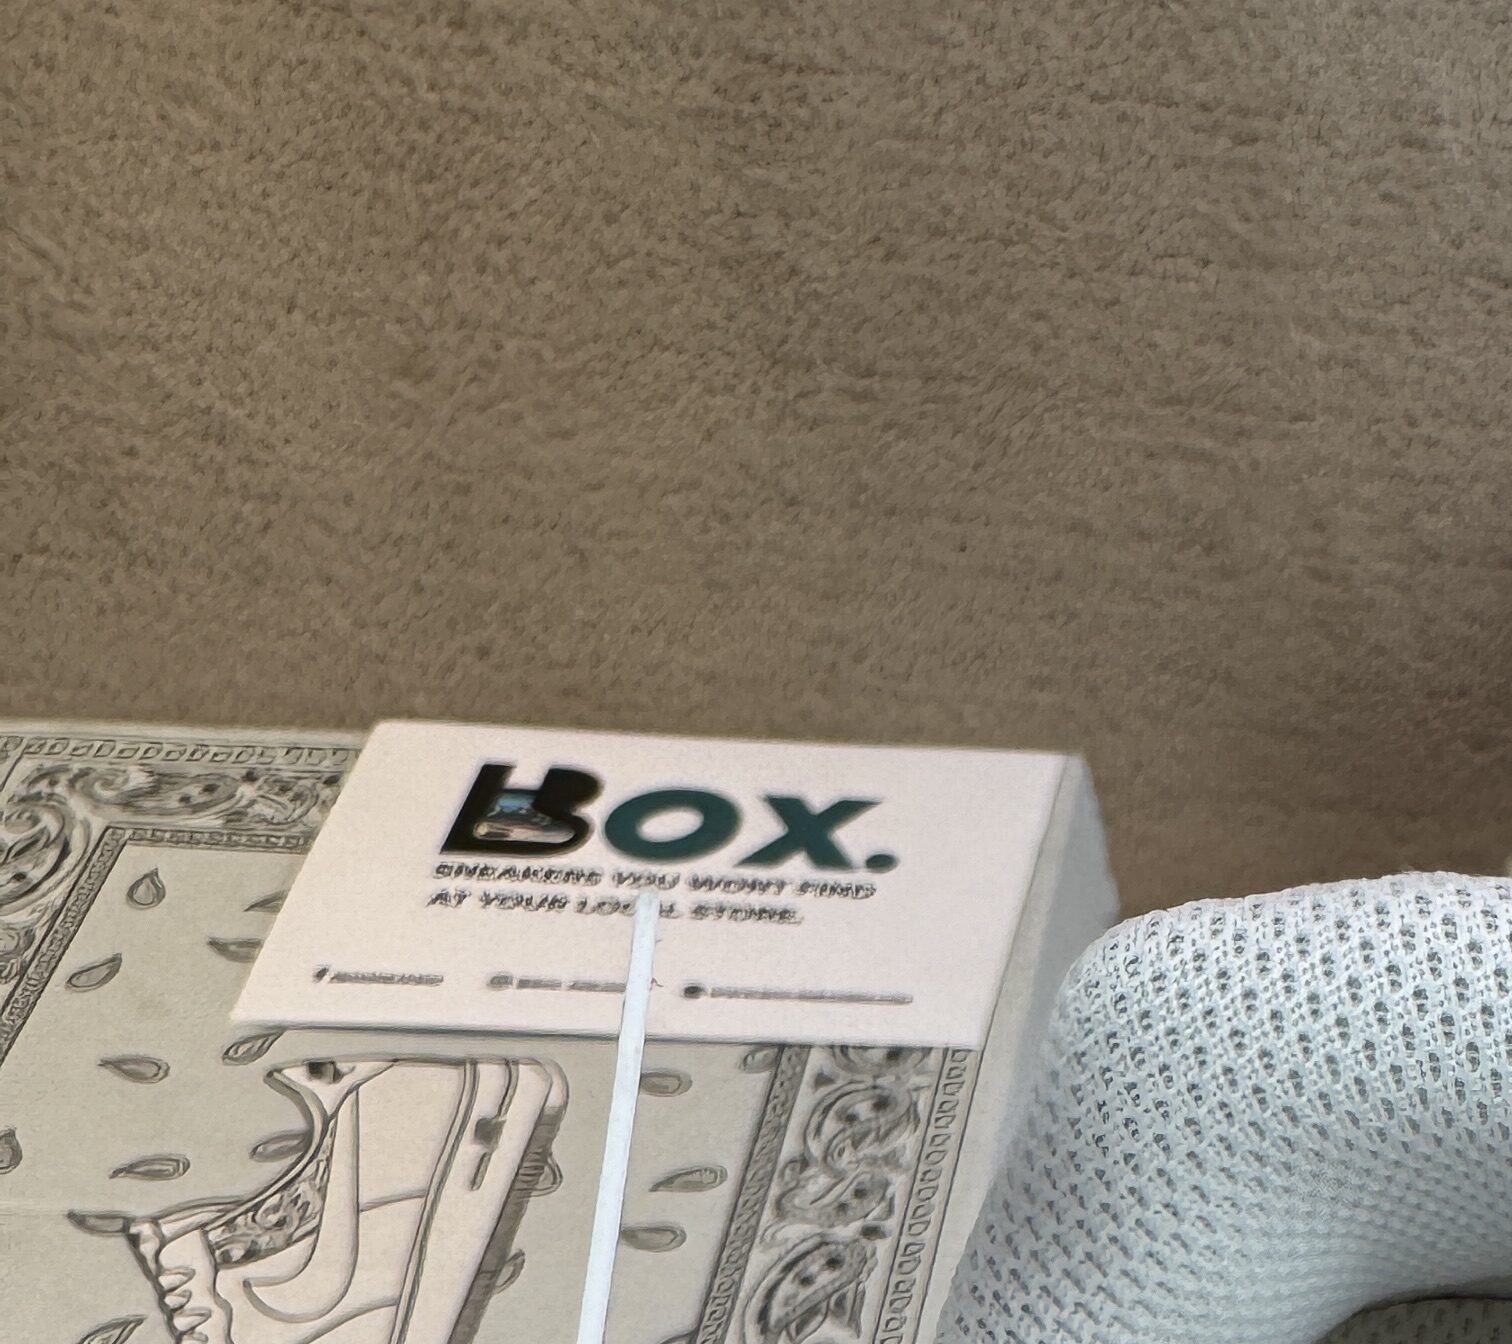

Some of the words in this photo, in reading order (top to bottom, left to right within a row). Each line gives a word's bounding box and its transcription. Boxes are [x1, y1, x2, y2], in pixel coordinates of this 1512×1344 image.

[612, 871, 681, 891] YOU
[427, 887, 470, 908] AT
[478, 890, 570, 913] YOUR
[574, 895, 679, 920] LOCL
